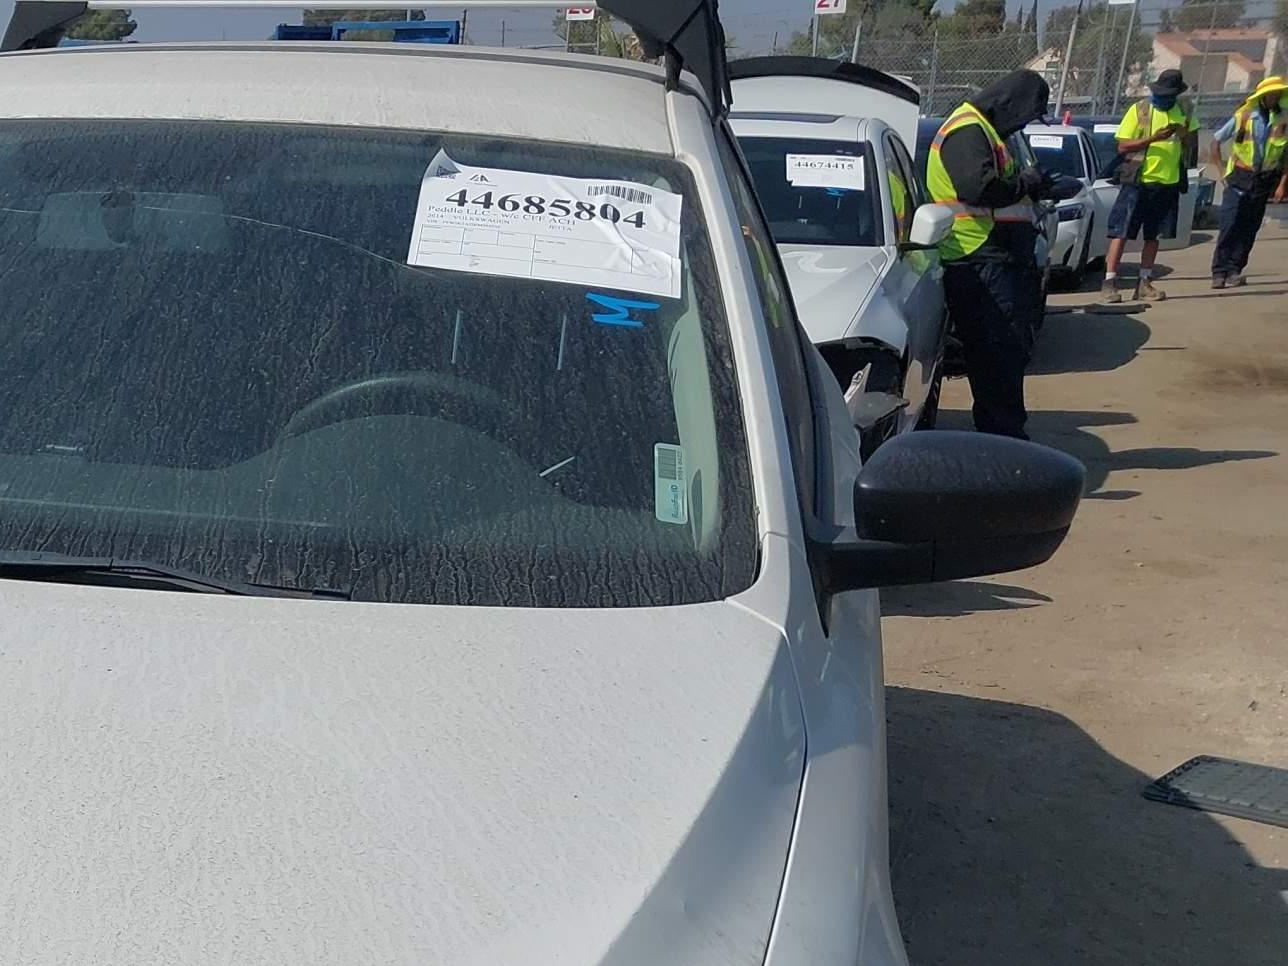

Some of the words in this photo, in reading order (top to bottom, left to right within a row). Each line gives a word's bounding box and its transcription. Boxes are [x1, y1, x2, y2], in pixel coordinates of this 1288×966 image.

[428, 205, 463, 214] Peddle
[466, 208, 491, 216] LLC
[446, 188, 646, 228] 44685804
